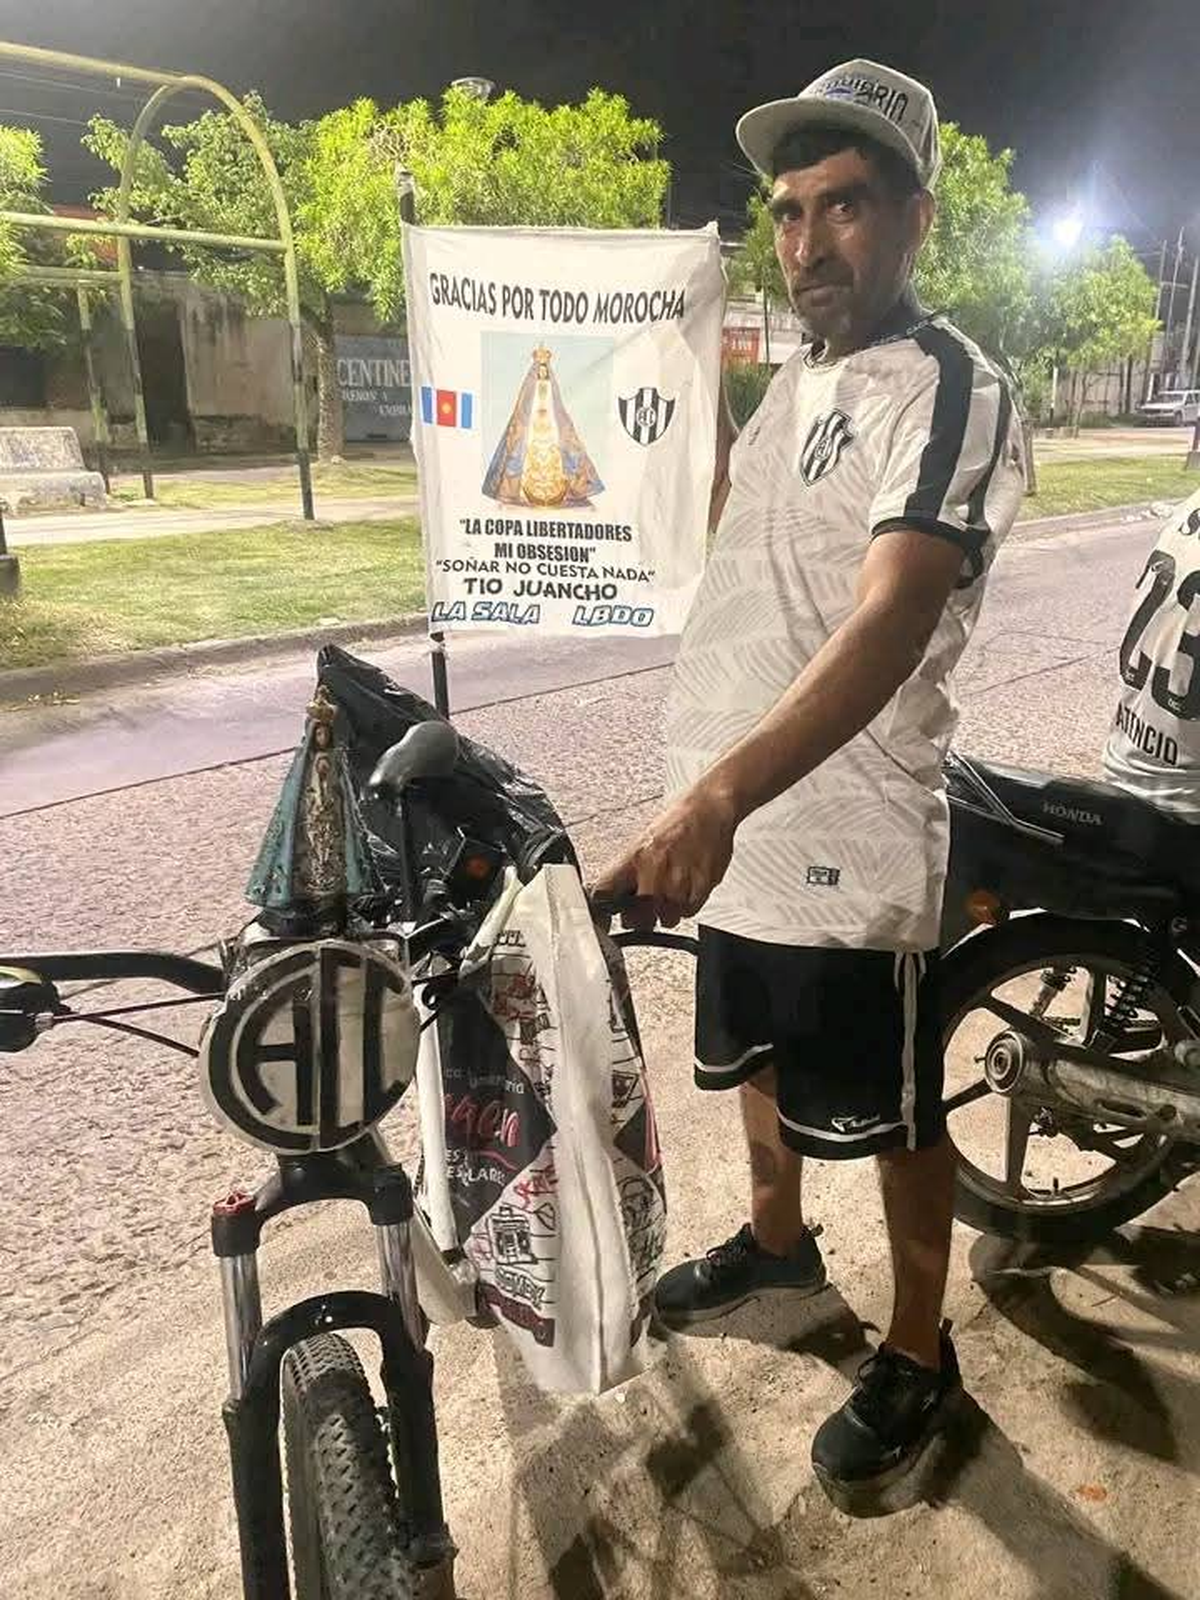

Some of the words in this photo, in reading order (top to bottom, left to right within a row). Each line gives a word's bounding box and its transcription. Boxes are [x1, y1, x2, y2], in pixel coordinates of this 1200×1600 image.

[429, 272, 497, 316] GRACIAS
[502, 284, 534, 320] POR
[539, 289, 589, 323] TODO
[592, 288, 686, 324] MOROCHA
[460, 518, 482, 535] "LA
[485, 518, 524, 537] COPA
[526, 519, 633, 542] LIBERTADORES
[494, 542, 513, 558] MI
[516, 543, 597, 563] OBSESION"
[436, 556, 500, 573] "SOÑAR
[505, 561, 531, 575] NO
[536, 562, 600, 579] CUESTA
[602, 565, 656, 582] NADA"
[463, 577, 503, 595] TIO
[513, 580, 618, 601] JUANCHO
[431, 600, 467, 623] LA
[471, 601, 541, 625] SALA
[572, 604, 655, 627] LBDO
[1042, 801, 1103, 826] HONDA
